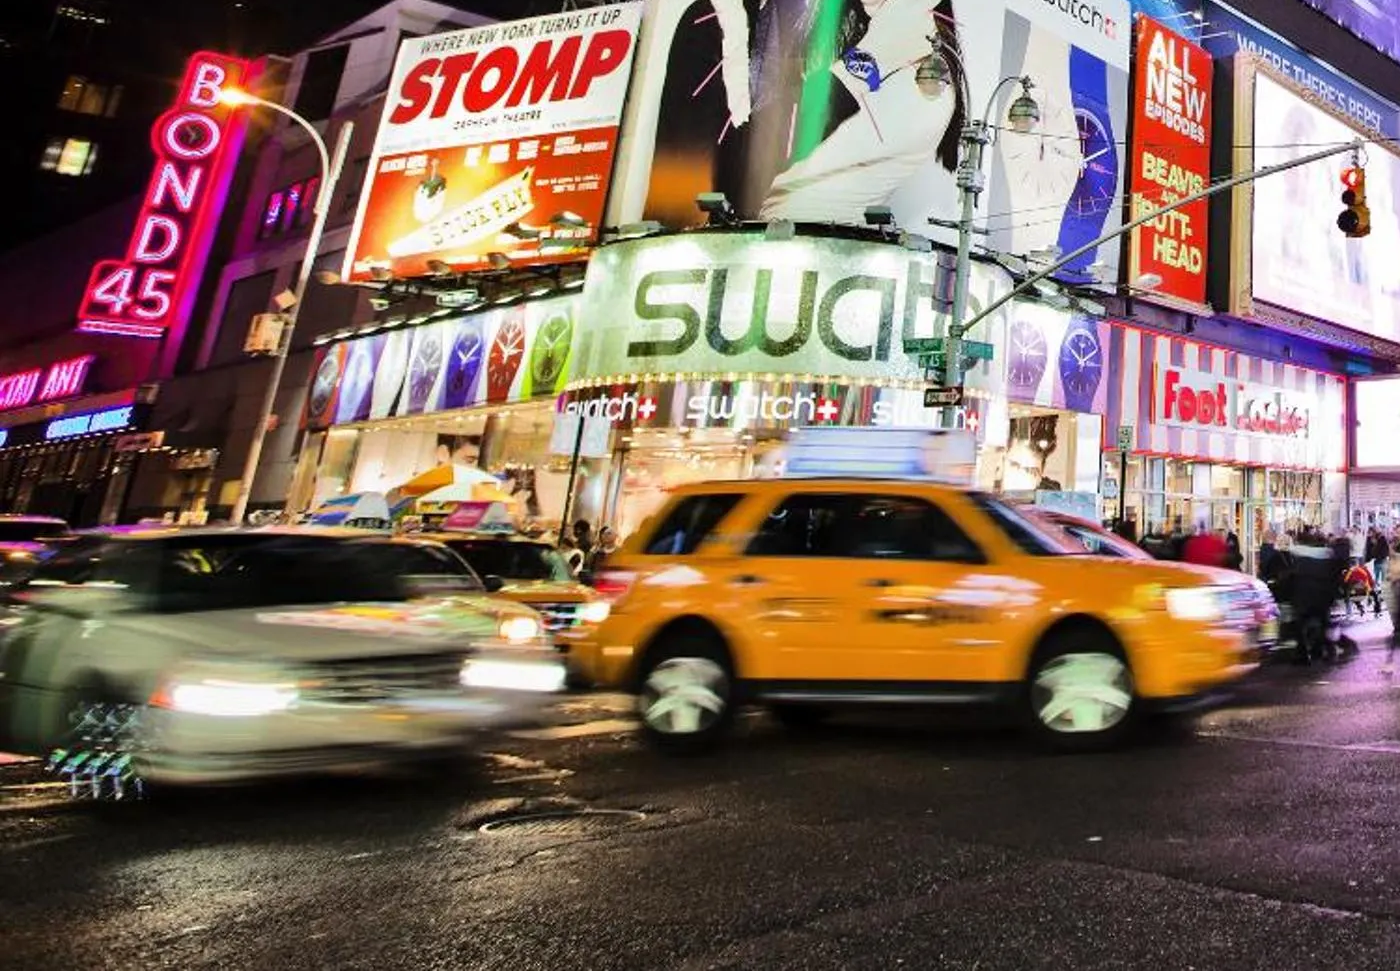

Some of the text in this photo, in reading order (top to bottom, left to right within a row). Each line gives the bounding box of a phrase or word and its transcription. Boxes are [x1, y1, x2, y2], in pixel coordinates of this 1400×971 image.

[421, 9, 621, 55] WHERE NEW YORK TURNS IT UP
[1147, 30, 1197, 85] ALL
[388, 29, 632, 125] STOMP
[1145, 61, 1206, 122] NEW
[1144, 97, 1205, 144] EPISODES
[135, 63, 226, 262] BOND
[1142, 151, 1204, 195] BEAVIS
[1153, 234, 1203, 274] HEAD
[93, 267, 176, 318] 45
[686, 392, 816, 420] swatch
[1164, 369, 1227, 427] Foot
